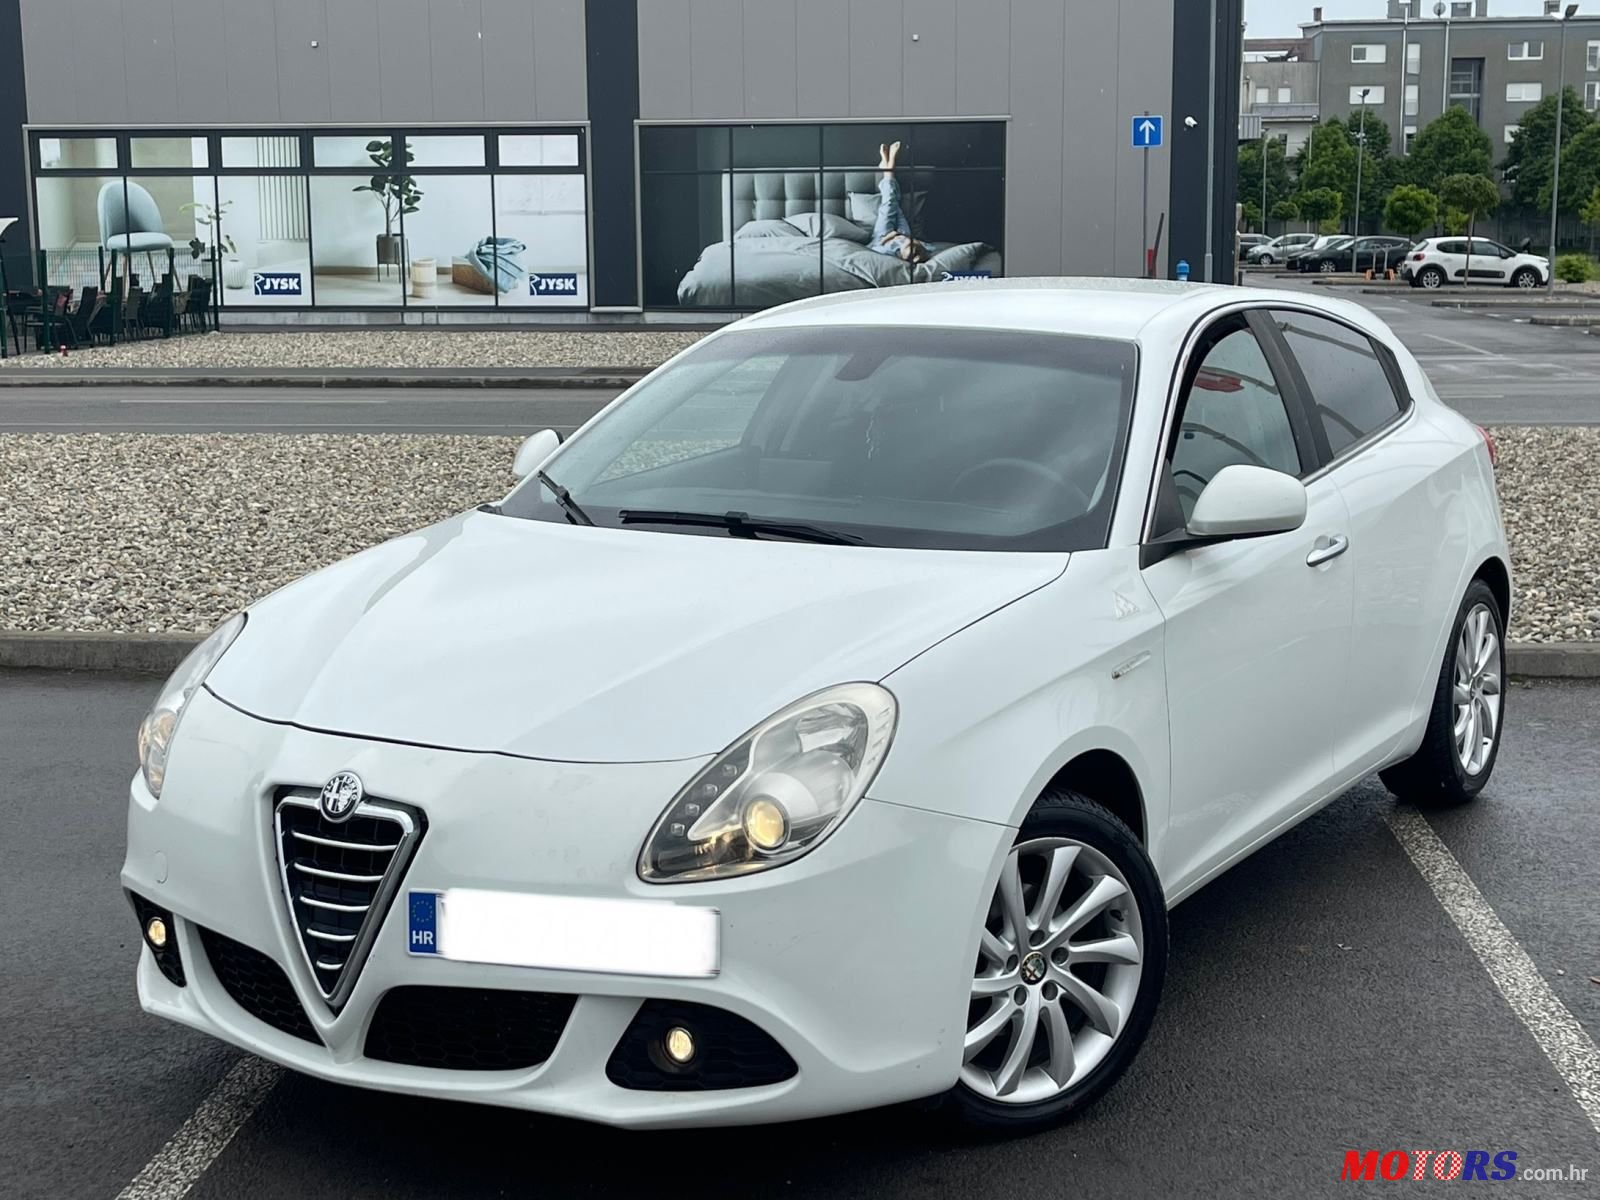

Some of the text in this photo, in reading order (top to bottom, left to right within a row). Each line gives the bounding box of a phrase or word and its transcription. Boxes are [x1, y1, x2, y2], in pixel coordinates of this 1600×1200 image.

[264, 278, 299, 290] JYSK
[539, 278, 575, 290] JYSK
[412, 930, 434, 945] HR
